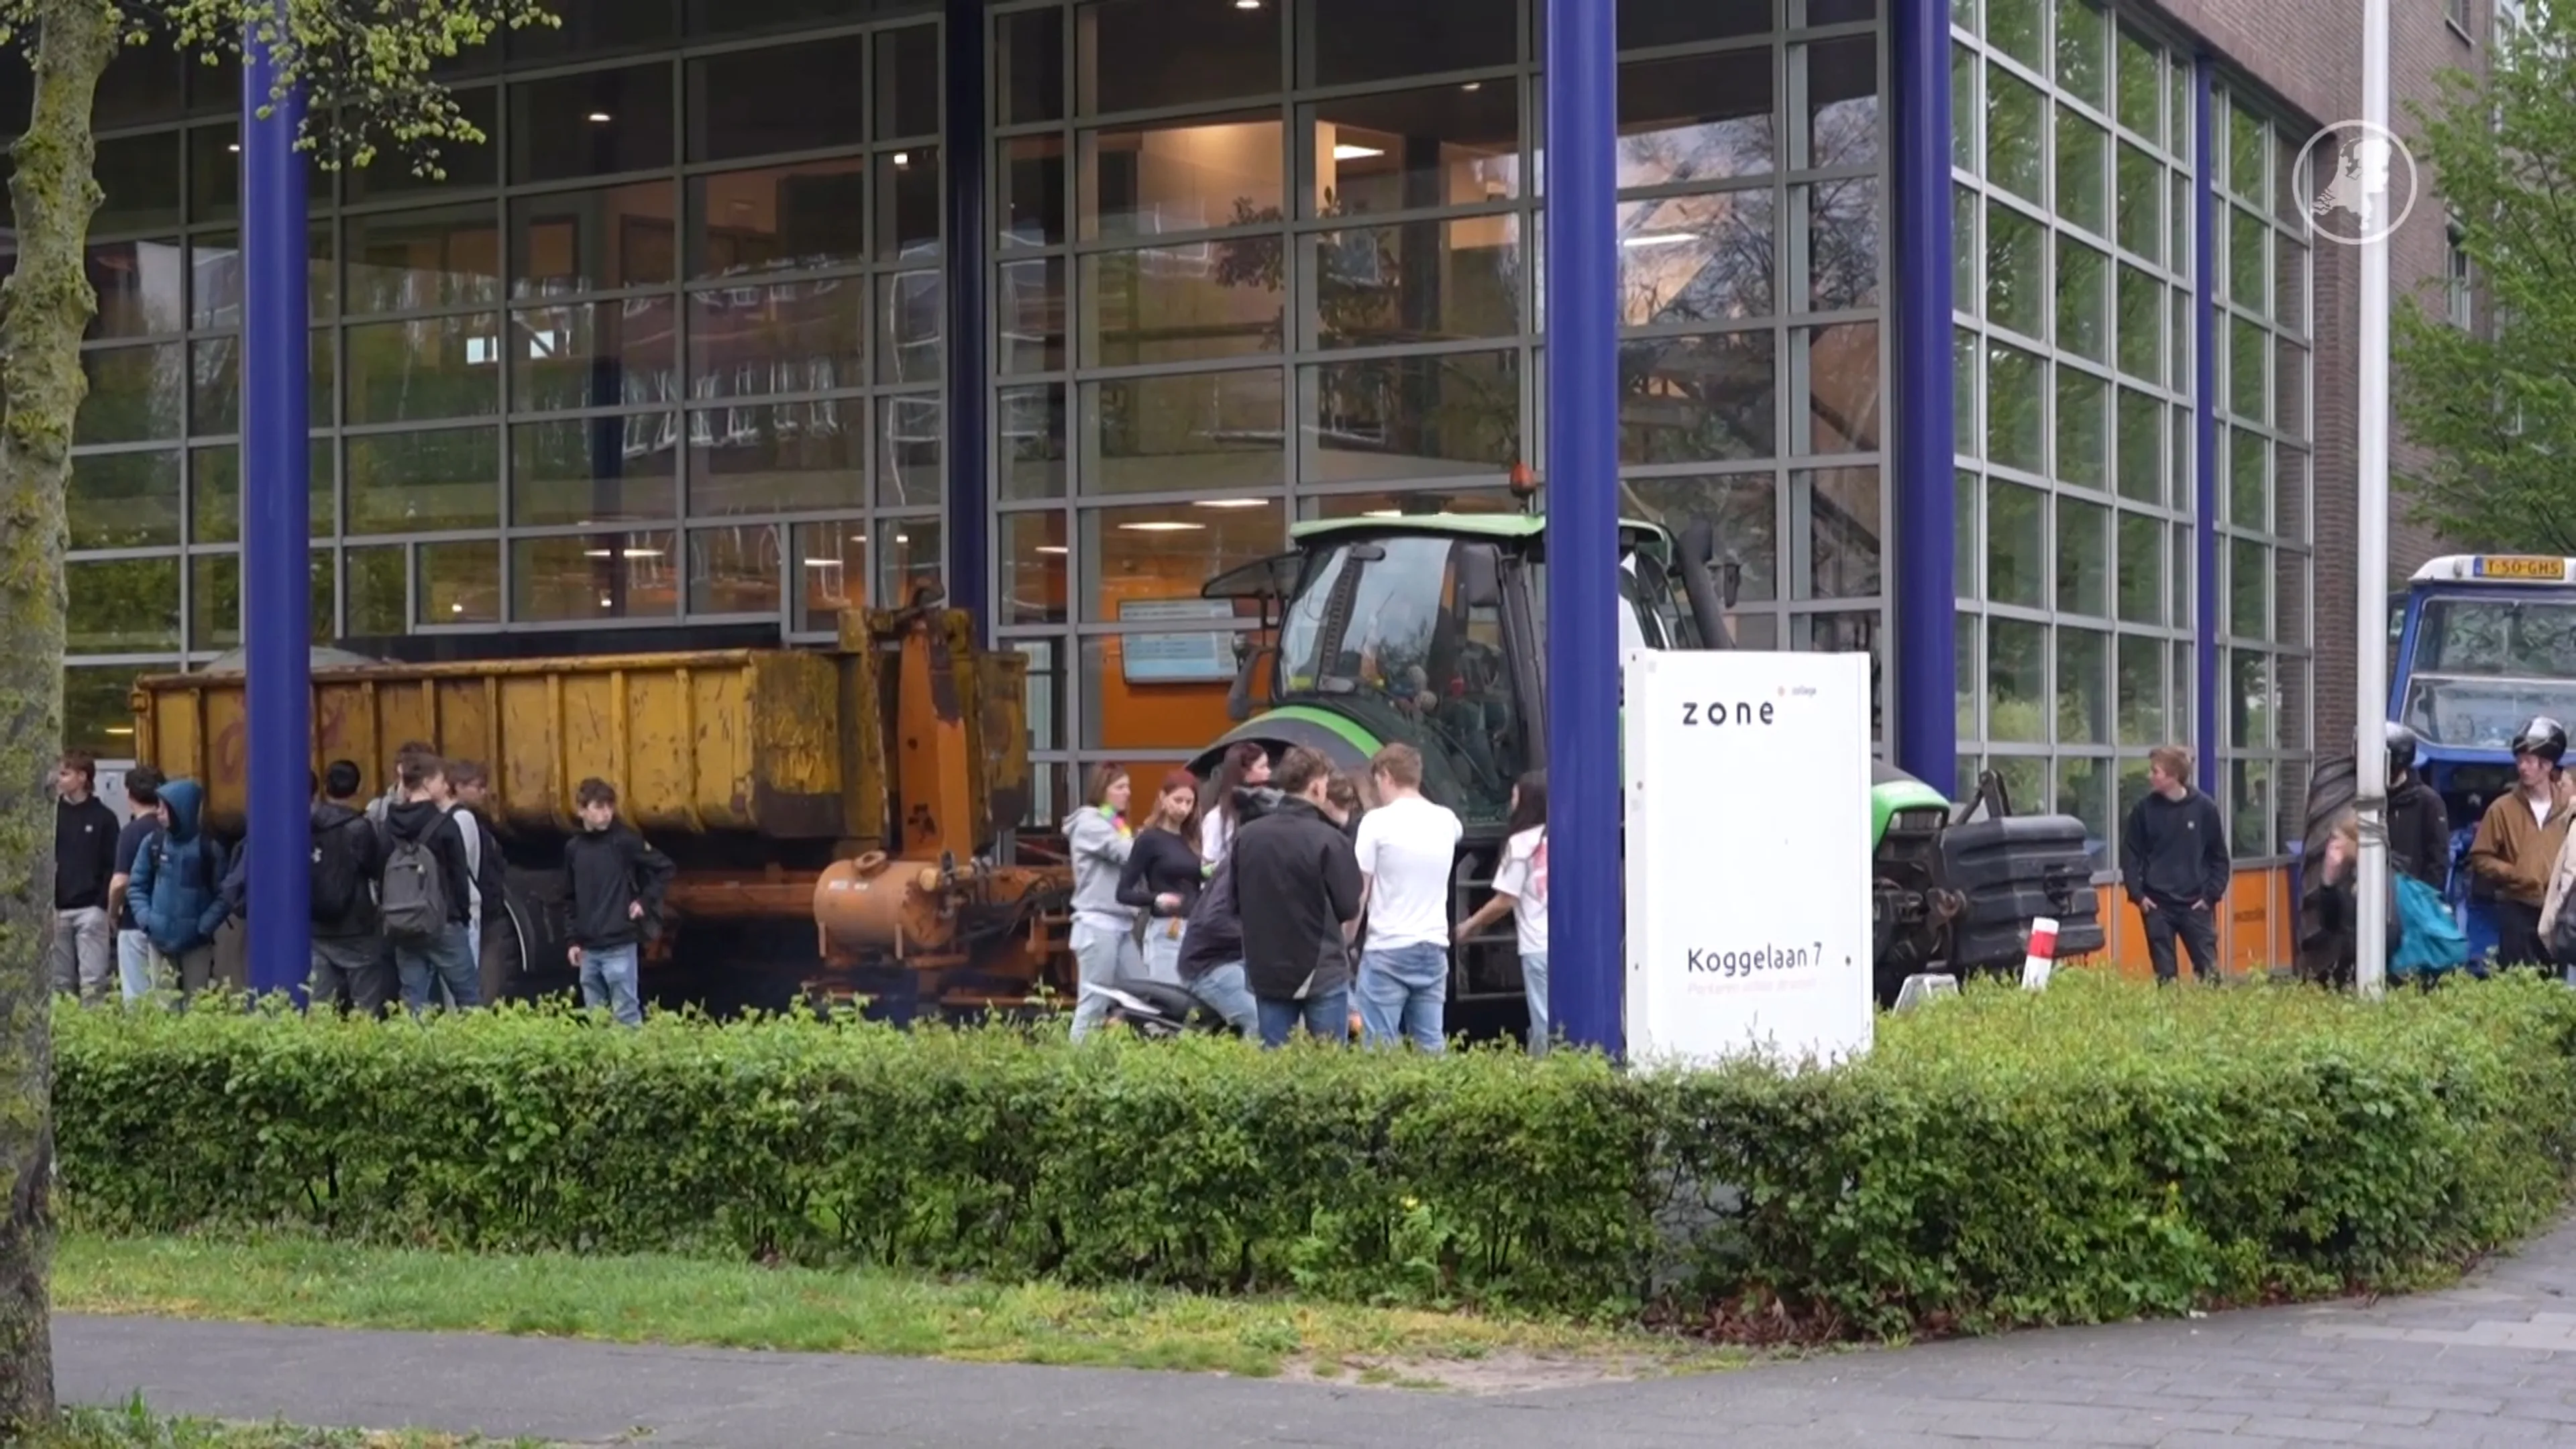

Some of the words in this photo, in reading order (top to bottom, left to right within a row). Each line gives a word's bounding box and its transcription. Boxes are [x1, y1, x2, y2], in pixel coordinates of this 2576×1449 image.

[1682, 701, 1774, 727] zone
[1688, 943, 1807, 977] Koggelaan
[1813, 941, 1822, 966] 7
